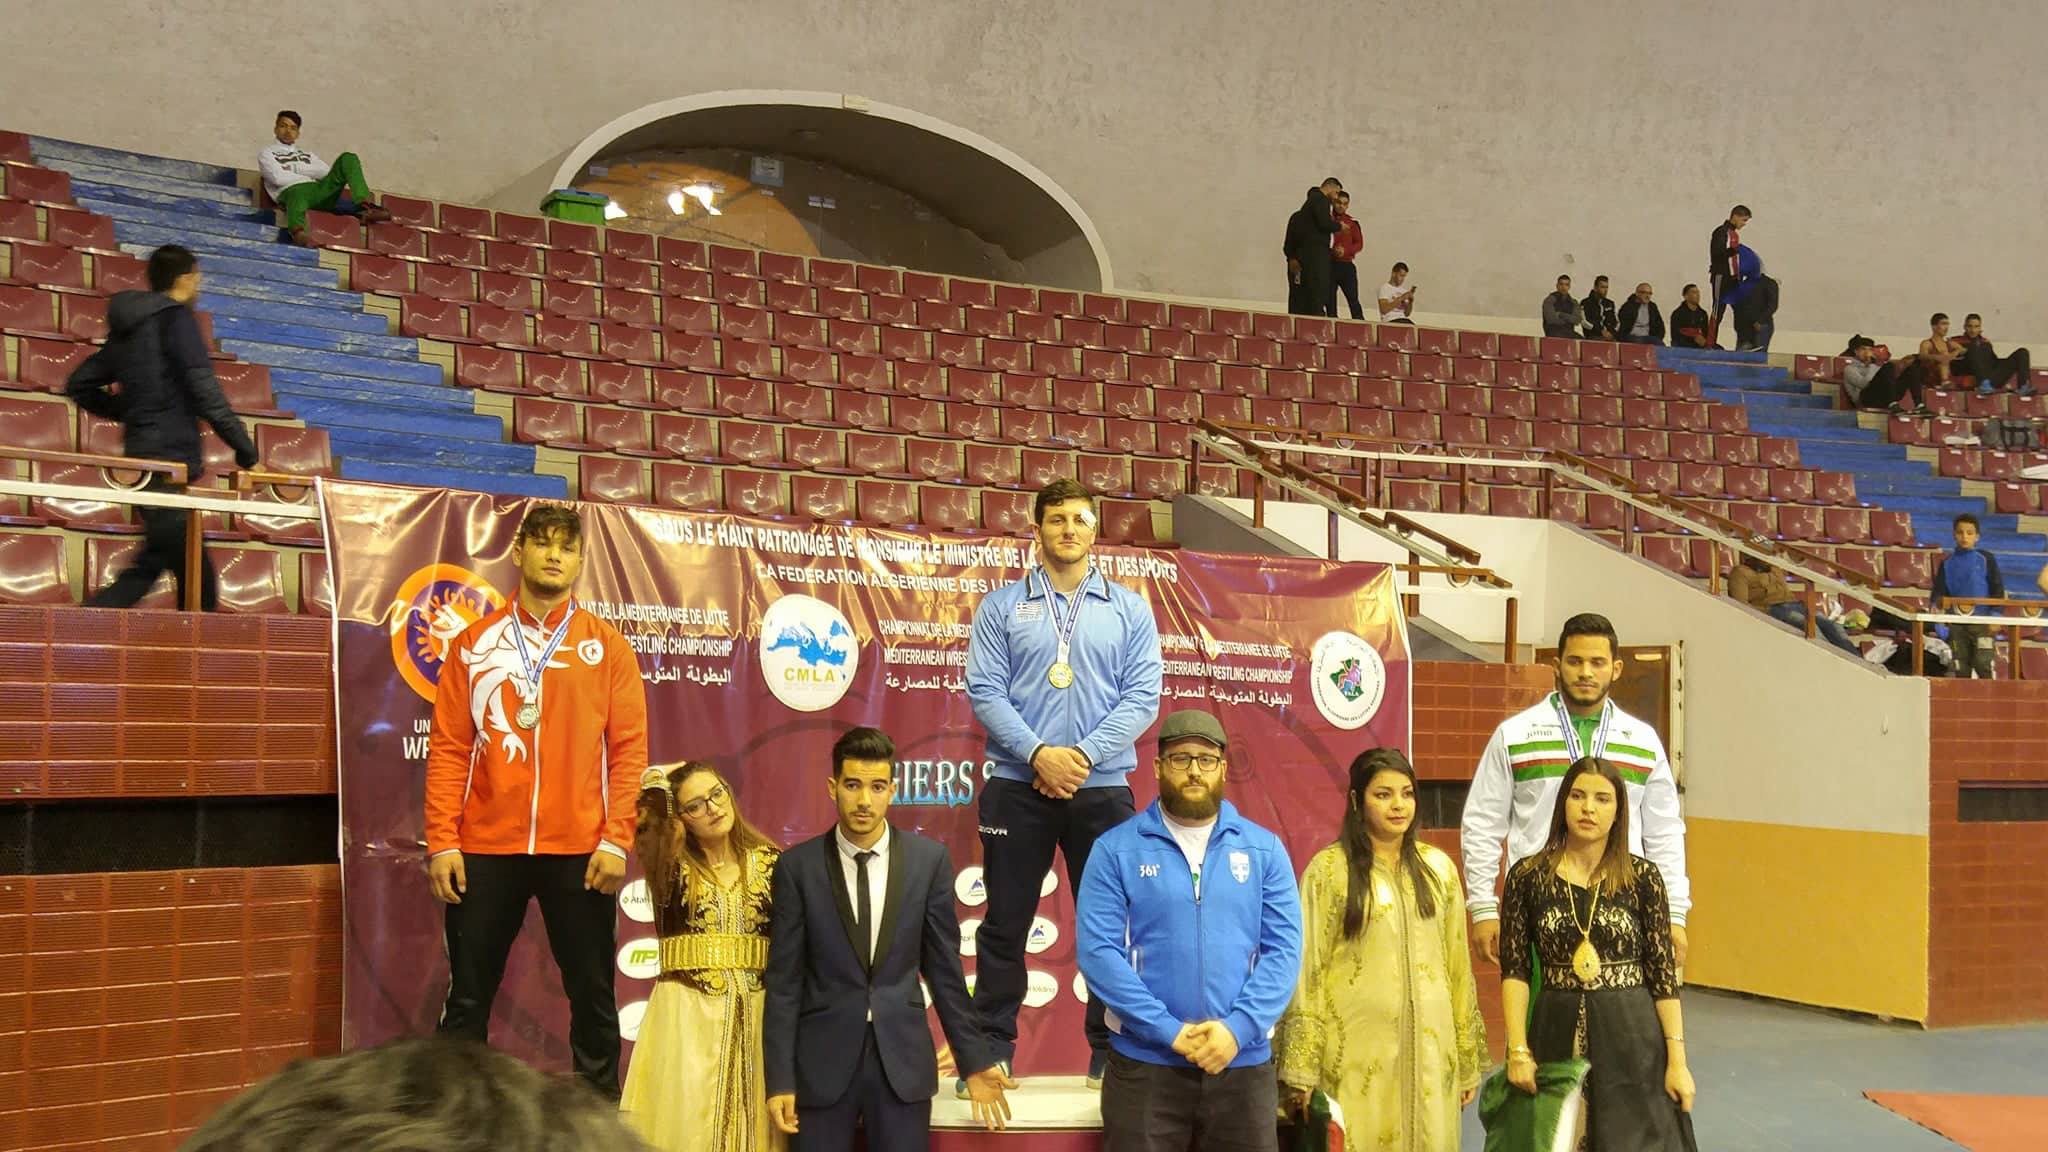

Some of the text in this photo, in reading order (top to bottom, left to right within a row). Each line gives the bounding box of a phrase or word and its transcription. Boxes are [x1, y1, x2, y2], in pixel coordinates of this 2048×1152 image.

[654, 519, 693, 544] SOUS
[696, 522, 714, 546] LE
[717, 524, 754, 549] HAUT
[758, 528, 836, 557] PATRONAGE
[838, 535, 855, 558] DE
[857, 537, 922, 563] MONSIEUR
[926, 543, 942, 564] LE
[944, 544, 1001, 567] MINISTRE
[1004, 547, 1020, 569] DE
[1022, 549, 1037, 570] LA
[1101, 555, 1114, 574] ET
[1117, 556, 1139, 577] DES
[1139, 558, 1177, 583] SPORTS
[757, 563, 777, 580] LA
[779, 565, 867, 587] FEDERATION
[871, 573, 958, 592] ALGERIENNE
[960, 578, 988, 593] DES
[599, 601, 611, 619] DE
[612, 602, 625, 619] LA
[625, 603, 689, 625] MEDITERRANEE
[690, 607, 702, 624] DE
[703, 608, 730, 628] LUTTE
[669, 637, 733, 657] CHAMPIONSHIP
[884, 648, 945, 666] MEDITERRANEAN
[686, 664, 731, 686] البطولة
[784, 668, 835, 682] CMLA
[885, 672, 940, 693] للمصارعة
[1246, 668, 1293, 684] CHAMPIONSHIP
[1160, 685, 1205, 699] للمصارع
[1258, 689, 1292, 707] البطولة
[630, 949, 659, 964] MP
